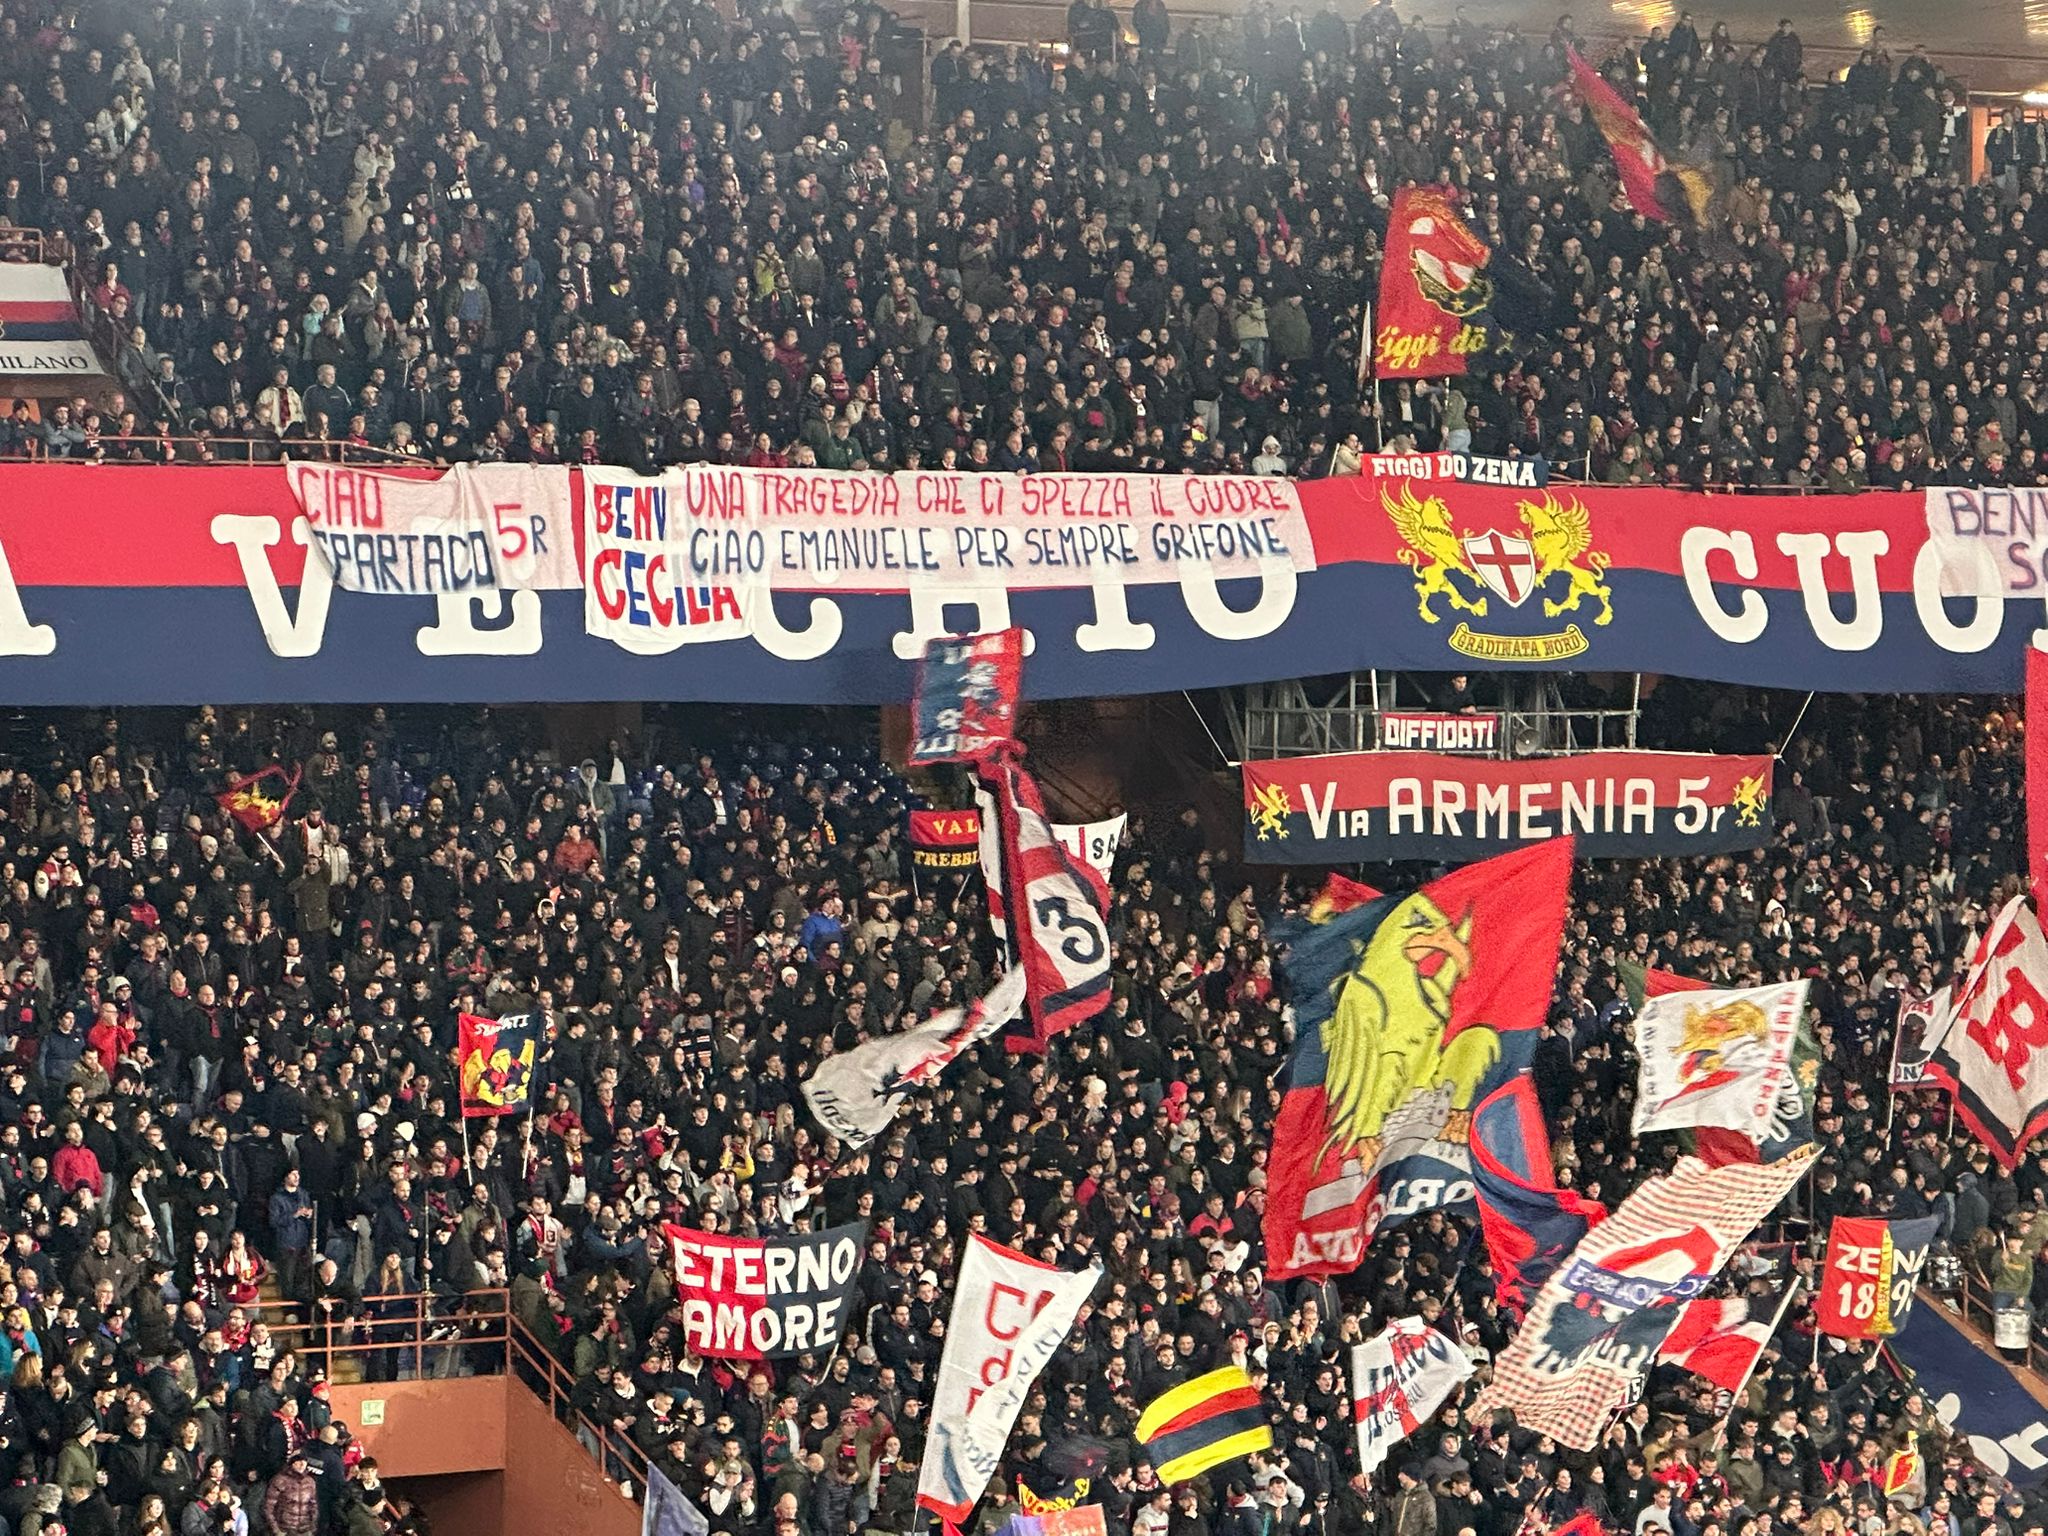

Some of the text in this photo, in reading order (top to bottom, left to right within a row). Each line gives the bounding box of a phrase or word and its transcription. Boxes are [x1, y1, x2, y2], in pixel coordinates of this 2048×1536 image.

[1371, 454, 1537, 487] FIGGI DO ZENA
[297, 466, 383, 529] CIAO
[685, 471, 745, 520] UNA
[916, 475, 966, 515] CHE
[1021, 477, 1132, 517] SPEZZA
[1184, 478, 1290, 516] CUORE
[780, 527, 940, 571] EMANUELE
[955, 525, 1014, 568] PER
[1024, 522, 1140, 568] SEMPRE
[2008, 541, 2048, 590] S
[1680, 525, 2048, 654] CUO
[1456, 633, 1581, 657] GRADINATA NORD
[1384, 717, 1494, 749] DIFFIDATI
[932, 818, 978, 835] VAL
[1388, 777, 1656, 841] ARMENIA
[672, 1236, 857, 1296] ETERNO
[682, 1296, 843, 1352] AMORE
